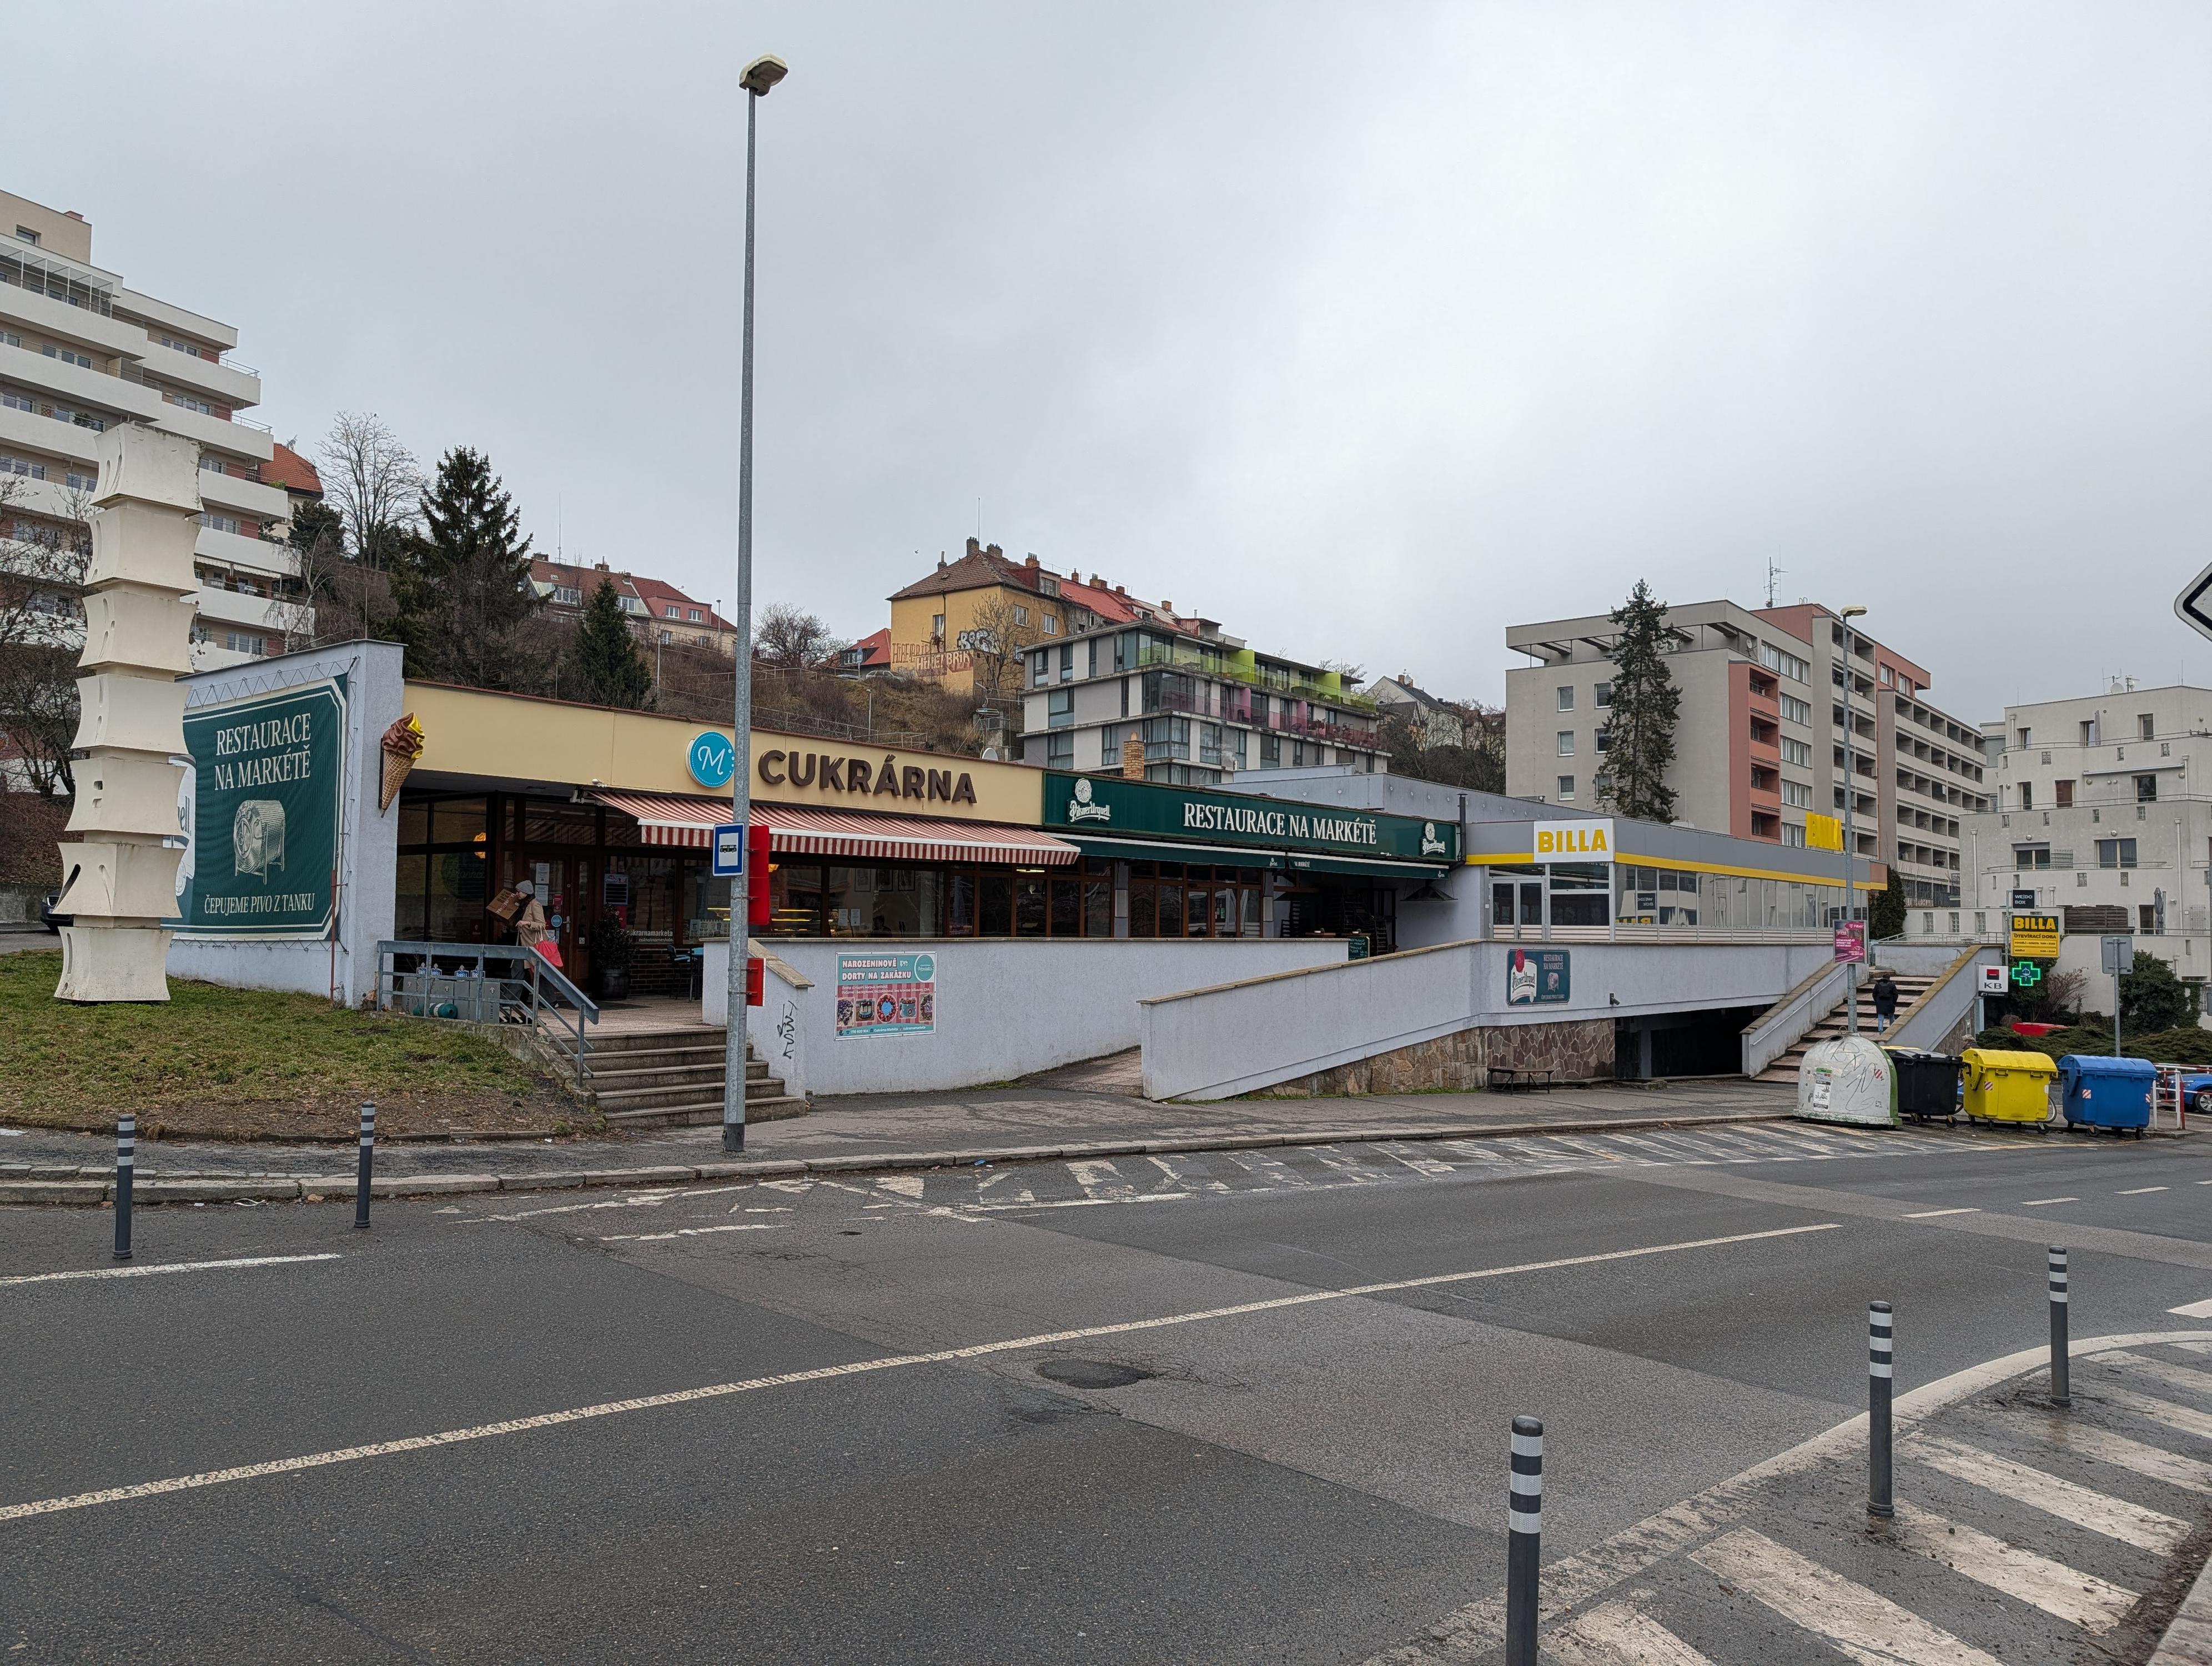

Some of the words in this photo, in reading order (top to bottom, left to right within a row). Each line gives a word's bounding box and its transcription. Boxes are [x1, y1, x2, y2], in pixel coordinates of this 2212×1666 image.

[216, 712, 311, 756] RESTAURACE
[214, 763, 234, 791] NA
[237, 744, 311, 788] MARKÉTĚ
[758, 749, 978, 804] CUKRÁRNA
[1184, 803, 1285, 836] RESTAURACE
[1289, 814, 1309, 838] NA
[1313, 817, 1377, 845] MARKÉTĚ
[1538, 829, 1608, 853] BILLA
[204, 894, 249, 916] ČEPUJEME
[250, 895, 273, 913] PIVO
[274, 895, 280, 912] Z
[282, 893, 315, 912] TANKU
[2014, 917, 2056, 930] BILLA
[842, 957, 897, 969] NAROZENINOVÉ
[842, 972, 866, 981] DORTY
[881, 969, 912, 980] ZAKÁZKU
